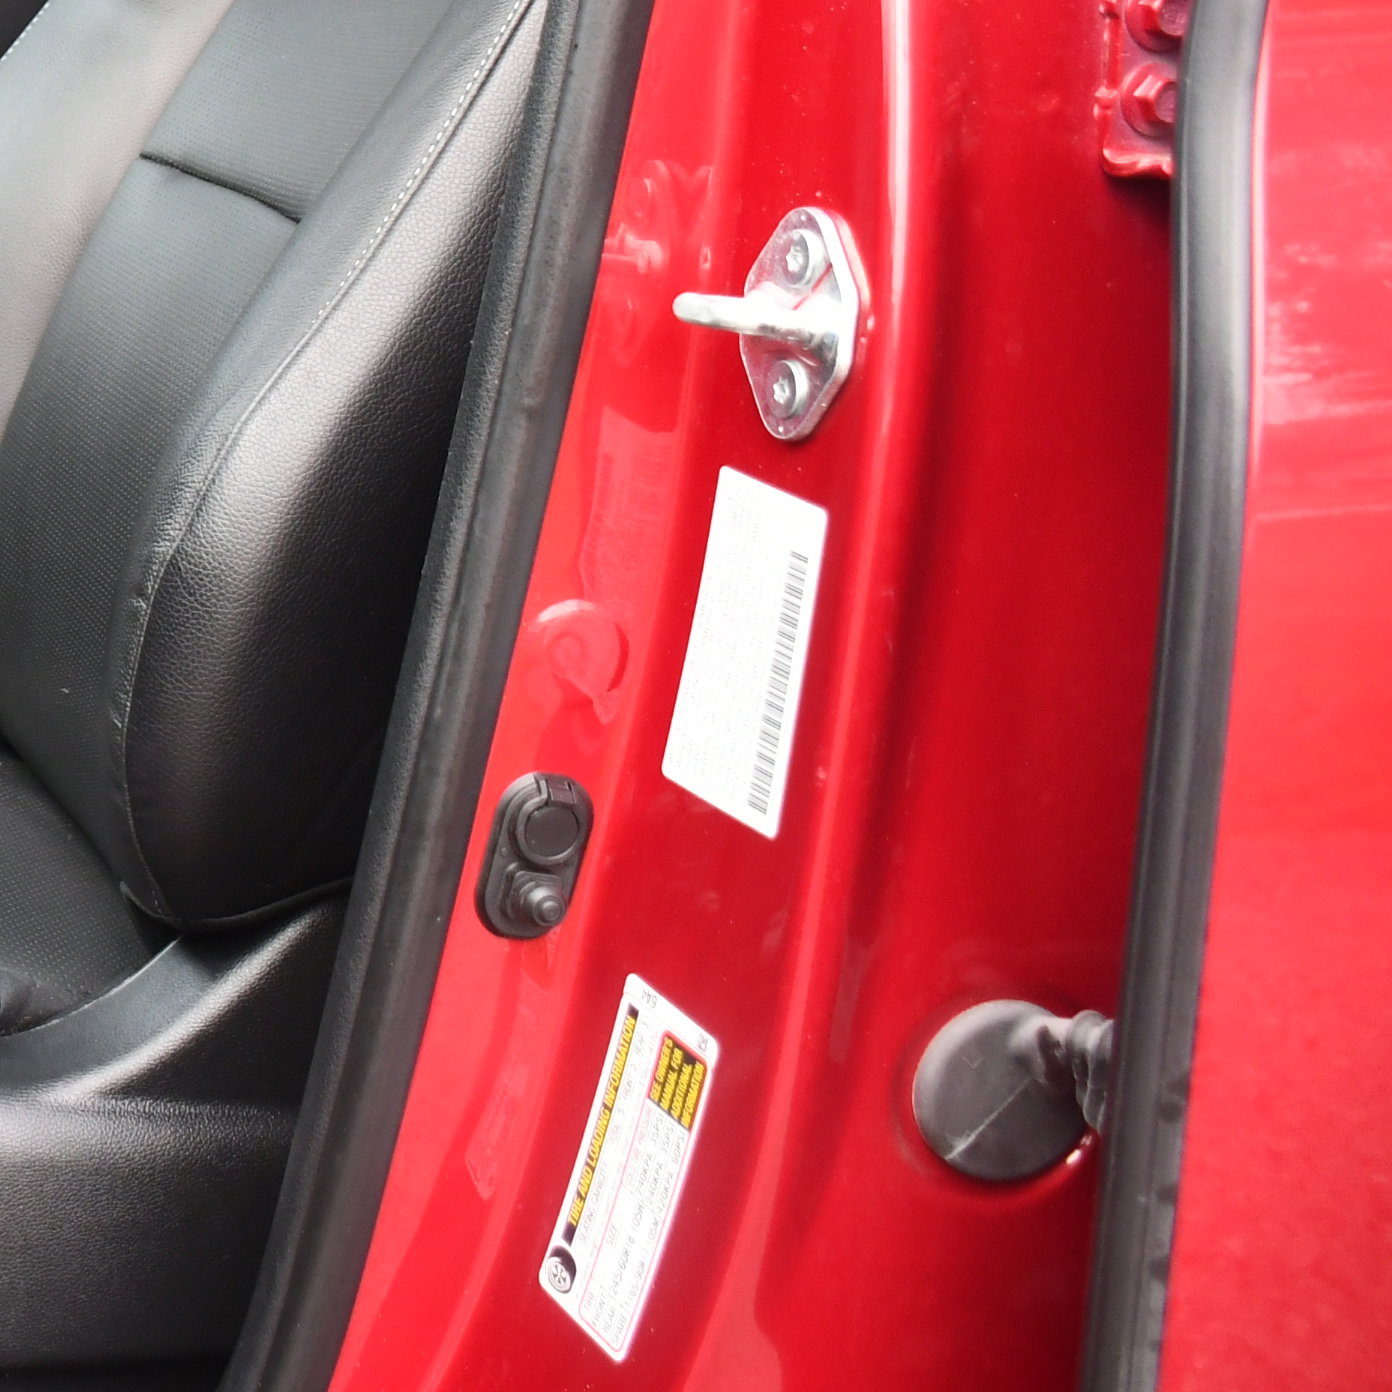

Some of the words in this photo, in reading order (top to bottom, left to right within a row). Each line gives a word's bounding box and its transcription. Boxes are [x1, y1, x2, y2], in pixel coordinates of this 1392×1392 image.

[649, 1080, 661, 1102] SEE
[660, 1069, 678, 1111] MANUAL
[670, 1046, 684, 1071] FOR
[670, 1061, 693, 1120] ADDITIONAL
[679, 1062, 705, 1128] INFORMATION
[568, 1193, 583, 1228] TIRE
[577, 1163, 592, 1197] AND
[586, 1106, 609, 1167] LOADING
[603, 1015, 636, 1109] INFORMATION
[634, 1151, 653, 1196] 240KPA
[645, 1160, 664, 1206] 240KPA
